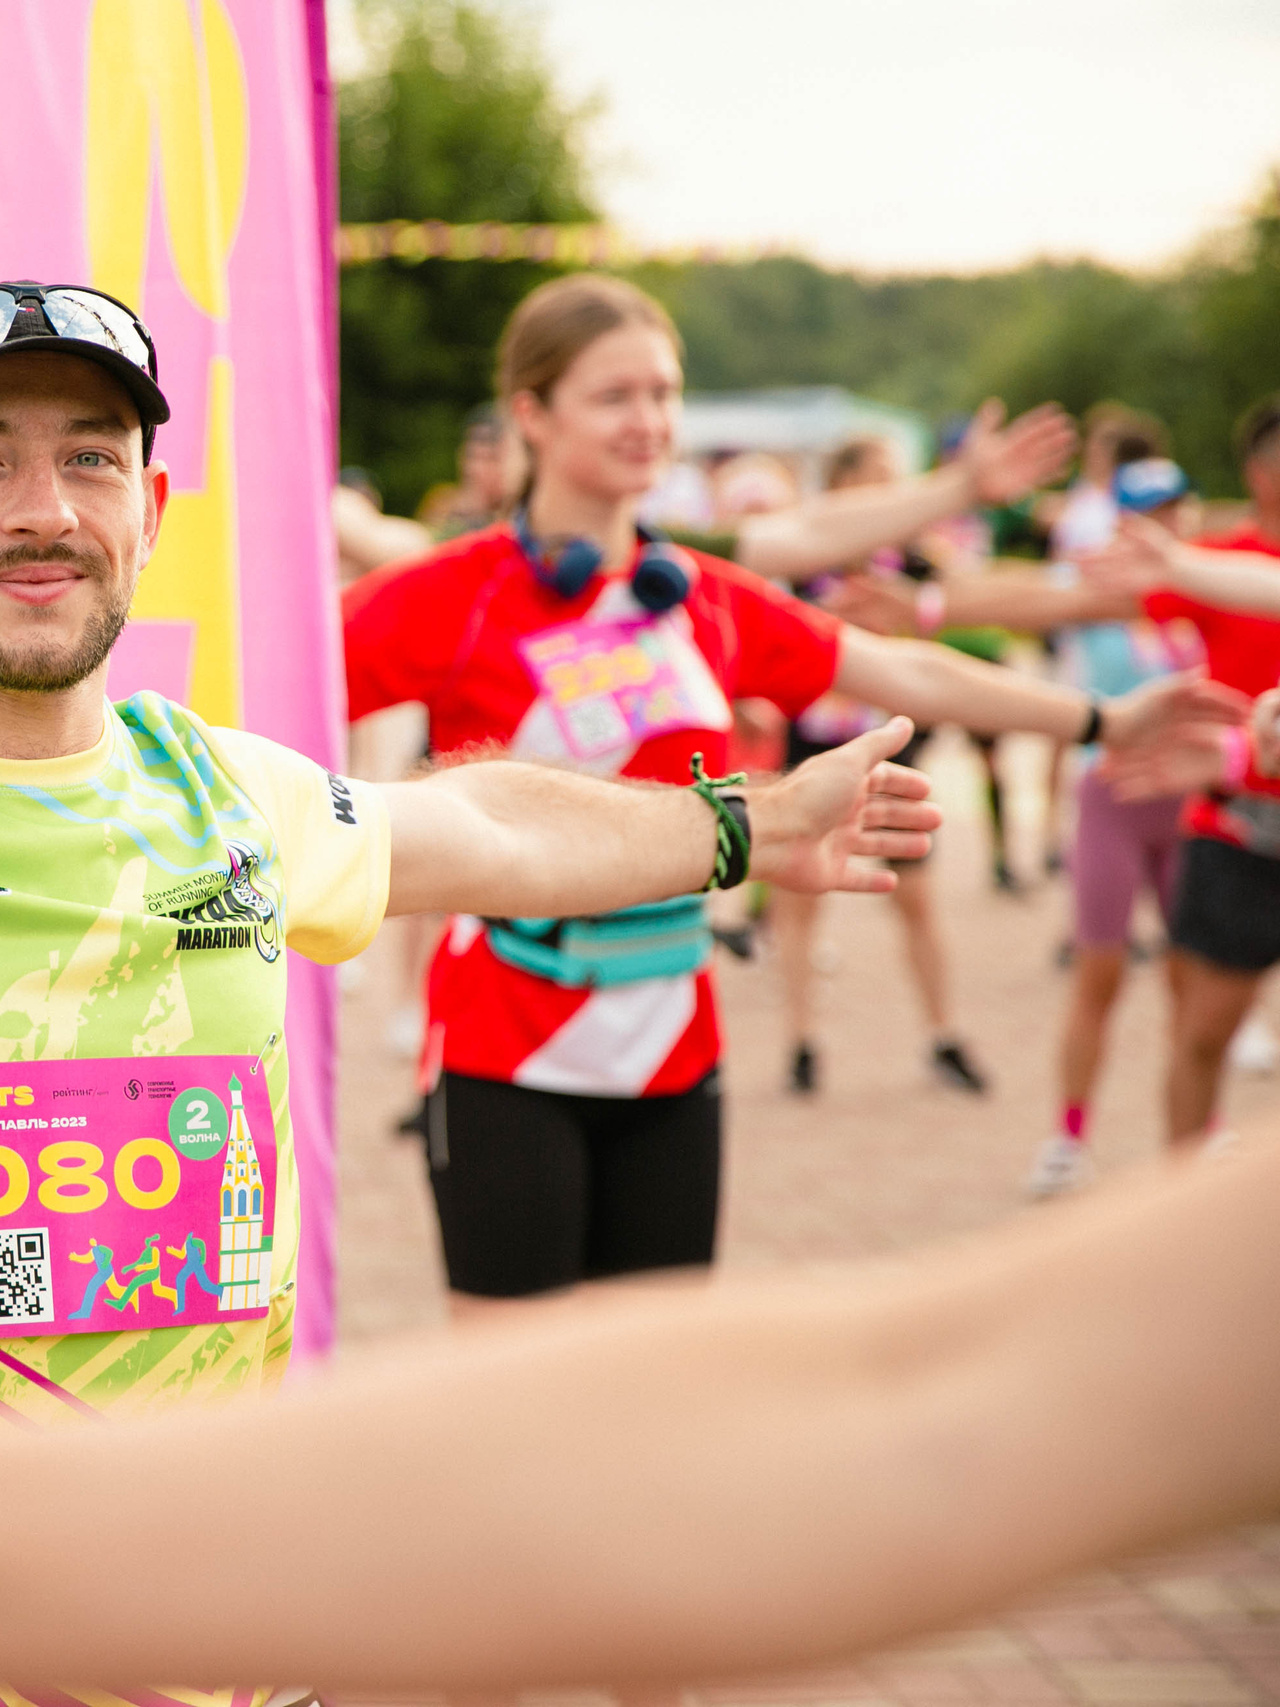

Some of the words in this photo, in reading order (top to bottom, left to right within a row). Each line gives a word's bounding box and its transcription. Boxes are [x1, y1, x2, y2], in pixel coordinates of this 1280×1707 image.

[142, 882, 192, 901] SUMMER
[193, 869, 229, 887] MONTH
[148, 900, 164, 912] OF
[167, 886, 213, 906] RUNNING
[176, 926, 251, 951] MARATHON
[50, 1116, 88, 1129] 2023
[185, 1099, 212, 1130] 2
[178, 1132, 222, 1145] ВОЛНА
